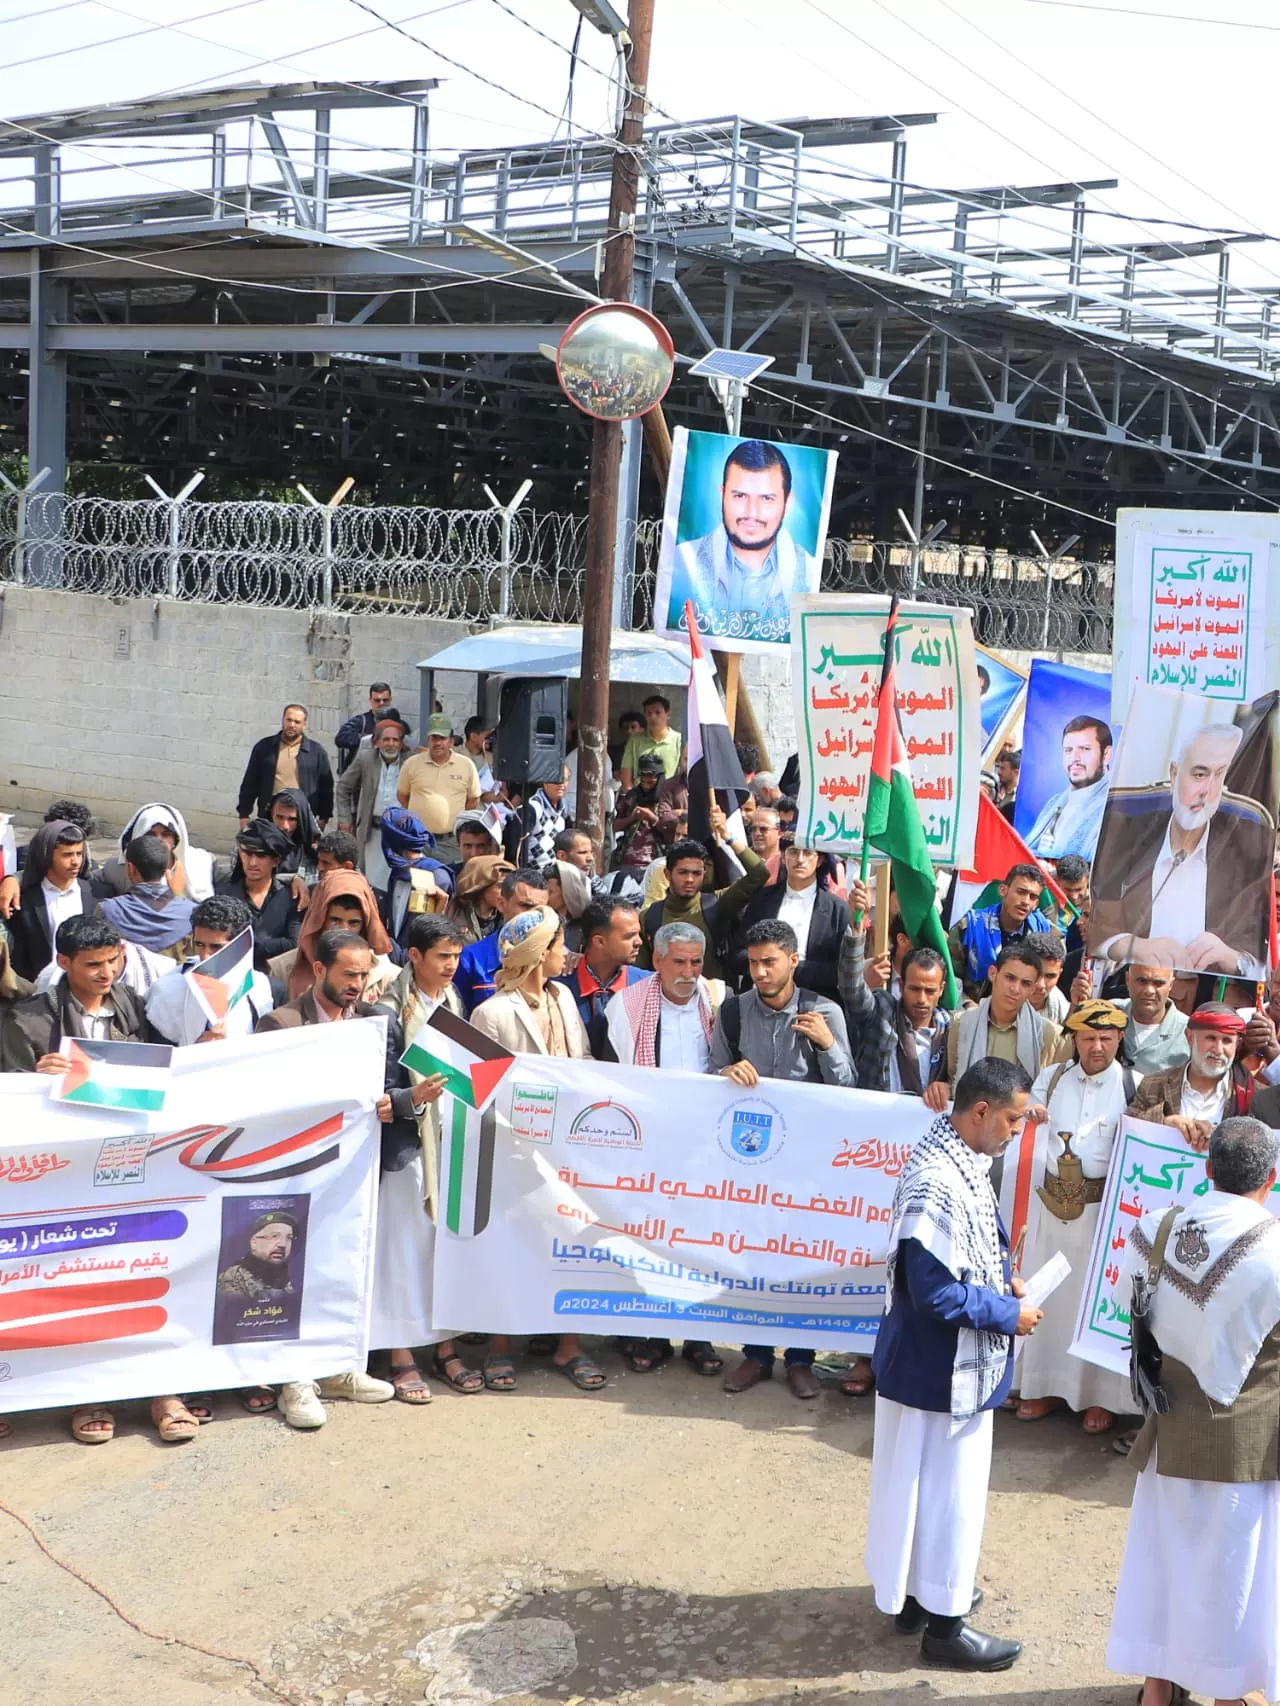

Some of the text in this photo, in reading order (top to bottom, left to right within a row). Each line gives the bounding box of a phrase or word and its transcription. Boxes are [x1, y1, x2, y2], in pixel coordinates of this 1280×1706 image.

[1156, 554, 1246, 587] الله أكبر
[1155, 587, 1245, 611] الموت لأمريكا
[1154, 614, 1244, 637] الموت لإسرائيل
[911, 625, 953, 668] الله
[1152, 641, 1243, 662] اللعنة على اليهود
[1151, 661, 1242, 692] النصر للإسلام
[817, 726, 954, 760] المو سرائيل
[818, 774, 867, 802] اليهود
[921, 814, 952, 846] الن
[1123, 1154, 1195, 1194] أكبر
[557, 1166, 893, 1223] وم الغضب العالمي لنصرة
[31, 1225, 77, 1250] شعار
[81, 1221, 118, 1240] تحت
[556, 1202, 887, 1268] زة والتضامن مع الأسرى
[0, 1252, 169, 1286] يقيم مستشفى الأمرا
[552, 1237, 684, 1279] للتكنولوجيا
[687, 1267, 765, 1292] الدولية
[840, 1282, 887, 1297] معة
[242, 1305, 283, 1319] فؤاد شكر
[612, 1296, 672, 1314] أغسطس
[688, 1304, 728, 1319] السبت
